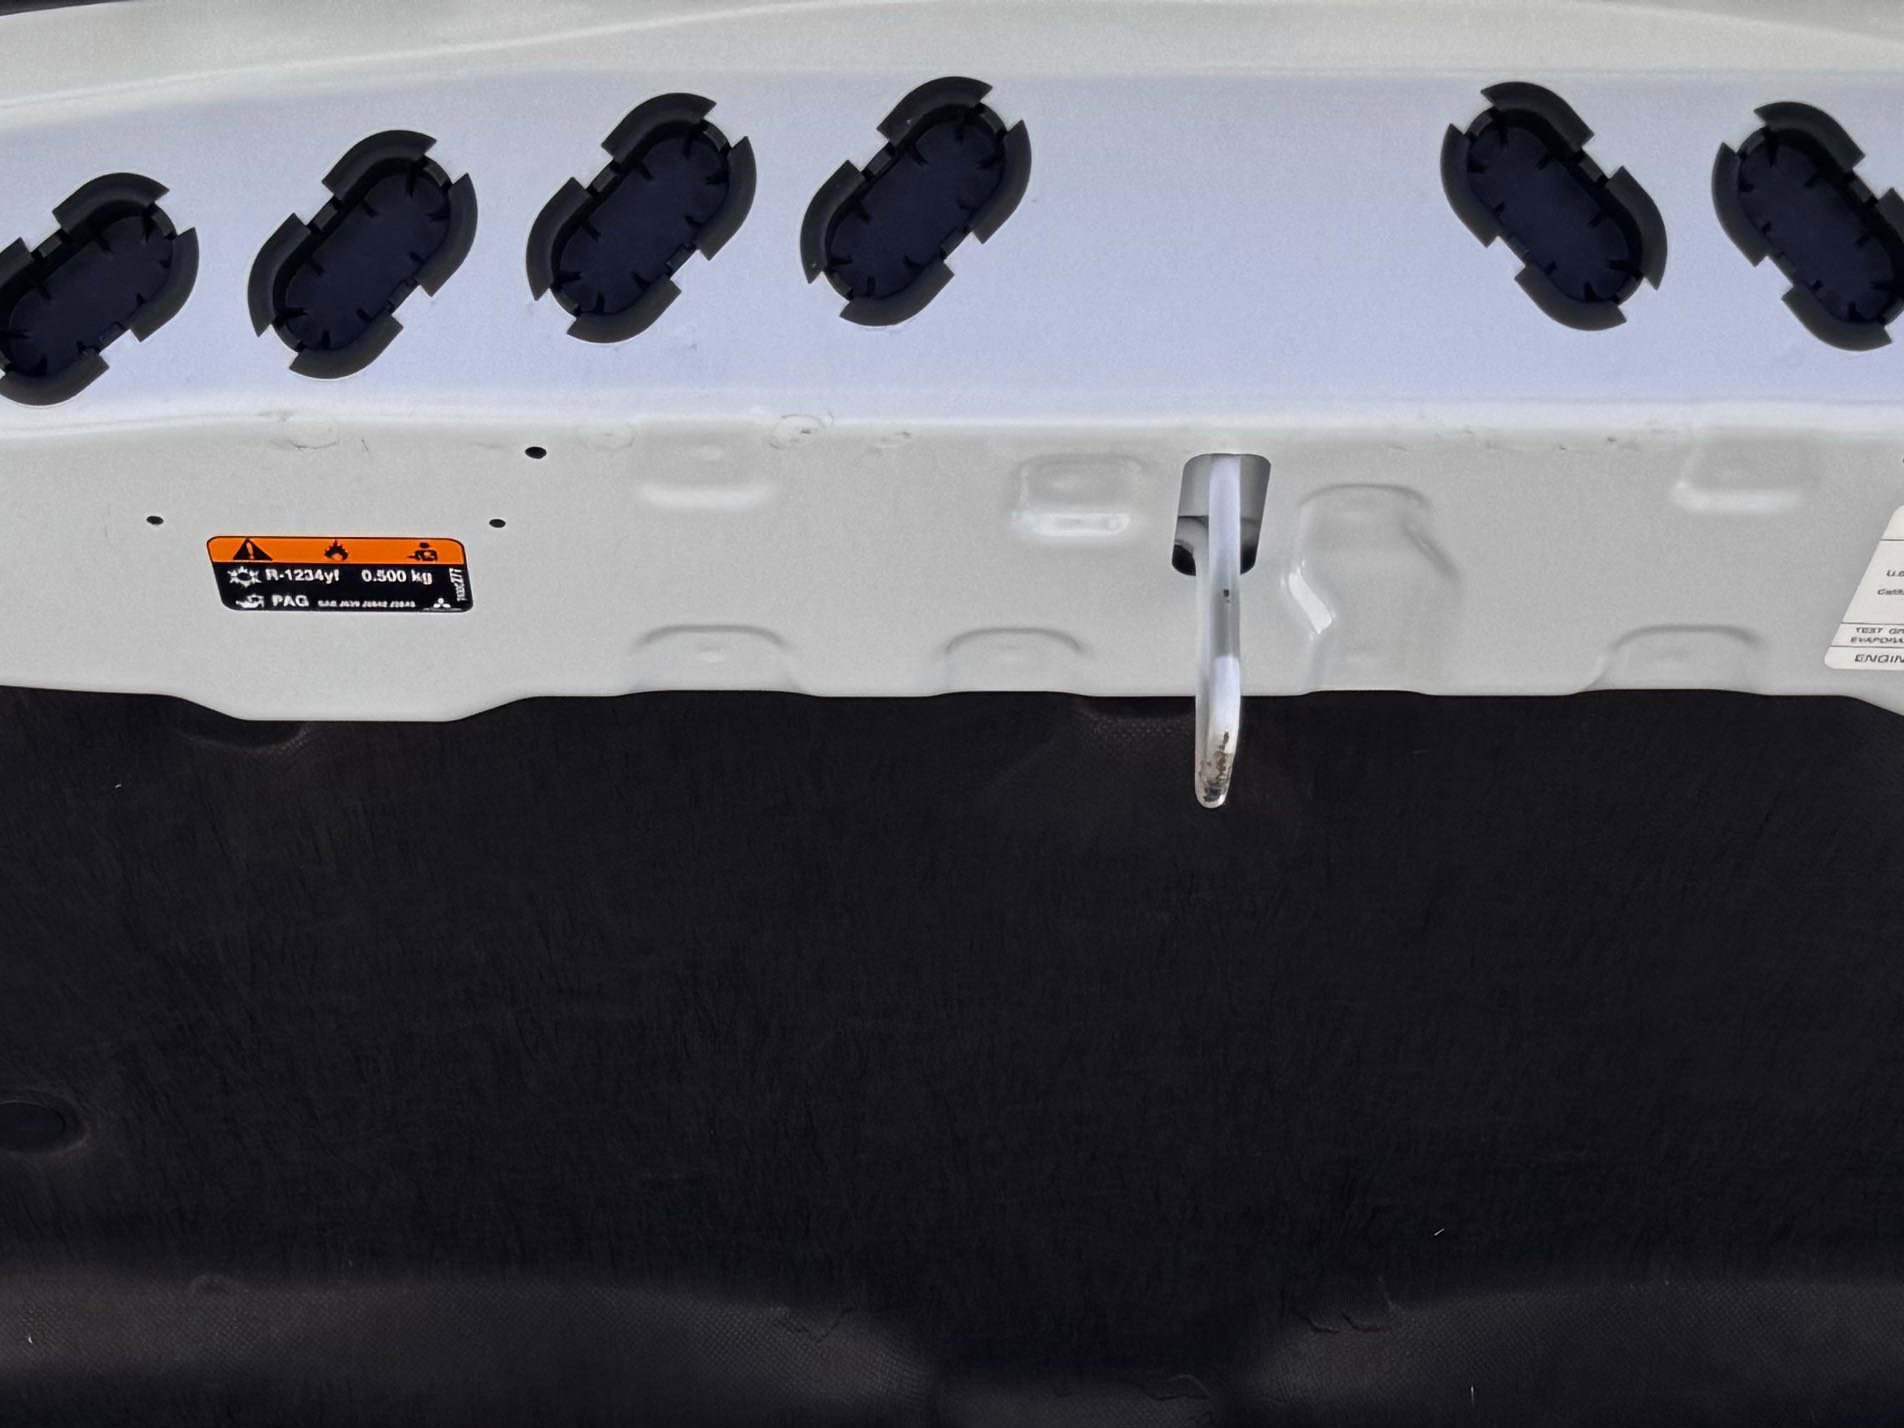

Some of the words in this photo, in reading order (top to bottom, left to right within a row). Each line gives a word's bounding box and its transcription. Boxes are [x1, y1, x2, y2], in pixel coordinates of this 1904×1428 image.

[361, 569, 407, 582] 0.500
[411, 569, 433, 585] kg
[271, 594, 309, 608] PAG
